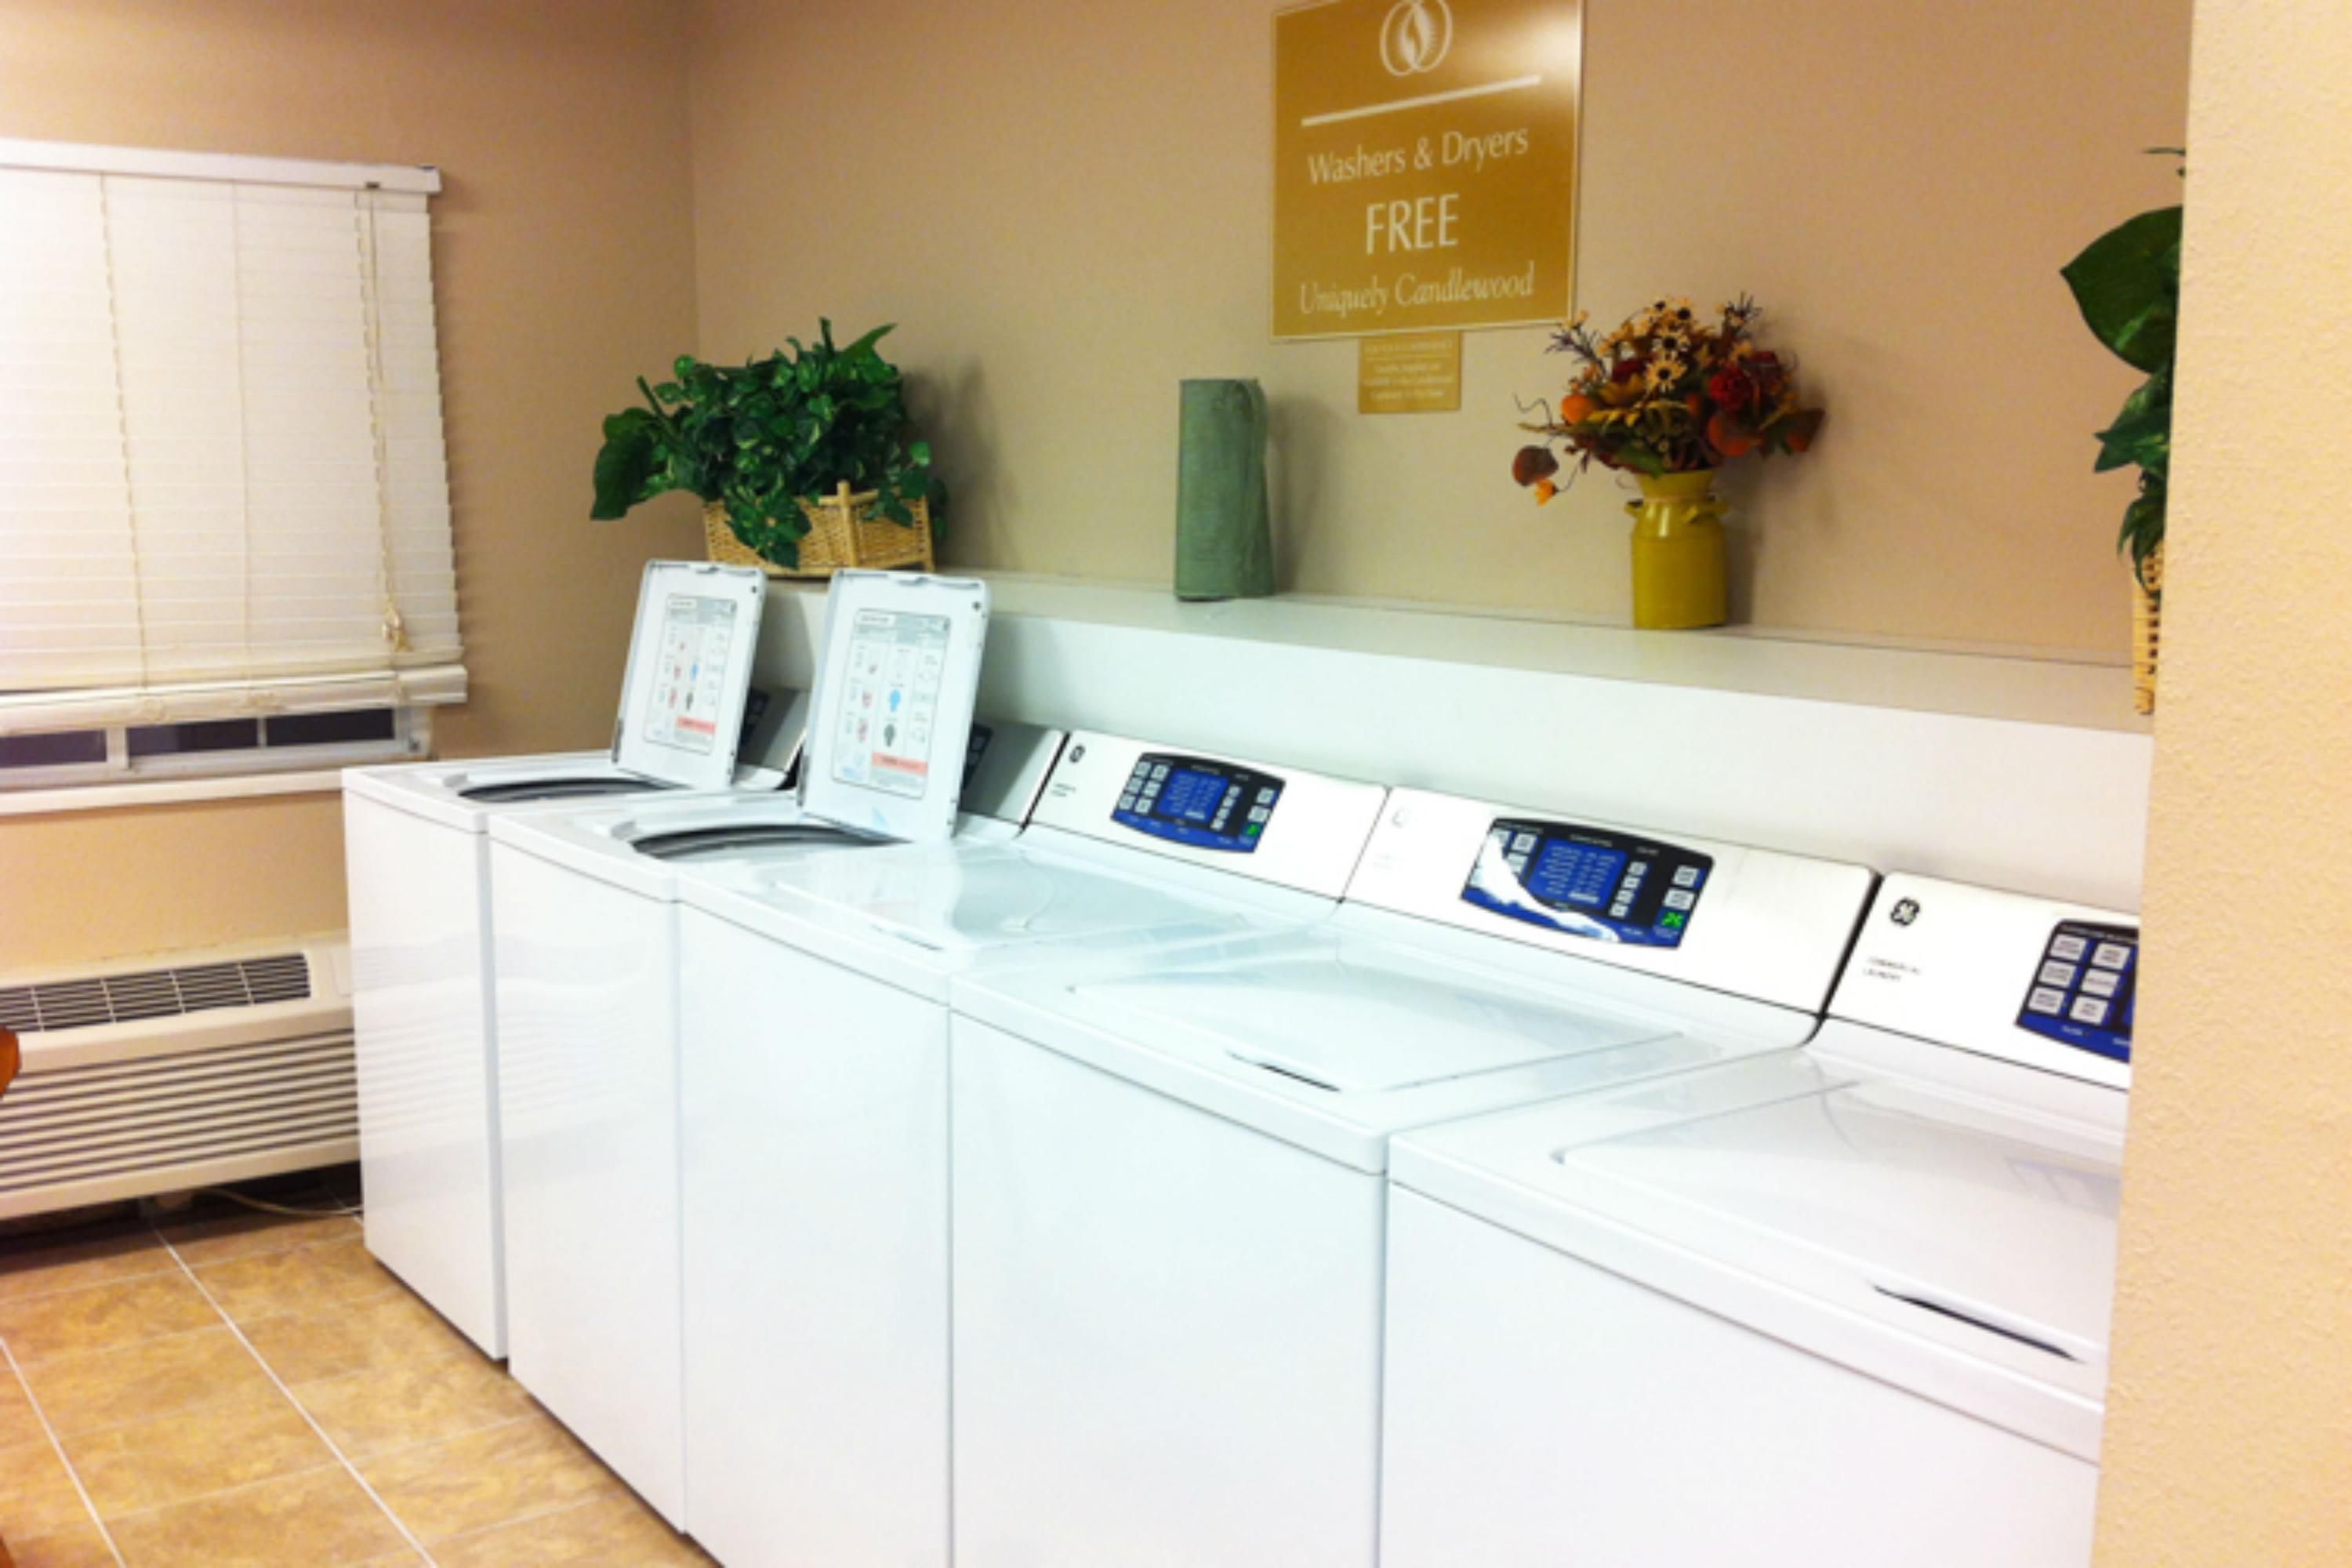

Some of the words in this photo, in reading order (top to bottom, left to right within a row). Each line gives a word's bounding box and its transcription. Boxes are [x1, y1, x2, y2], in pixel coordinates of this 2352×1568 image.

[1308, 143, 1406, 184] Washers
[1414, 136, 1433, 170] &
[1442, 128, 1529, 173] Dryers
[1367, 193, 1459, 255] FREE
[1300, 276, 1388, 318] Uniquely
[1396, 260, 1534, 306] Candlewood
